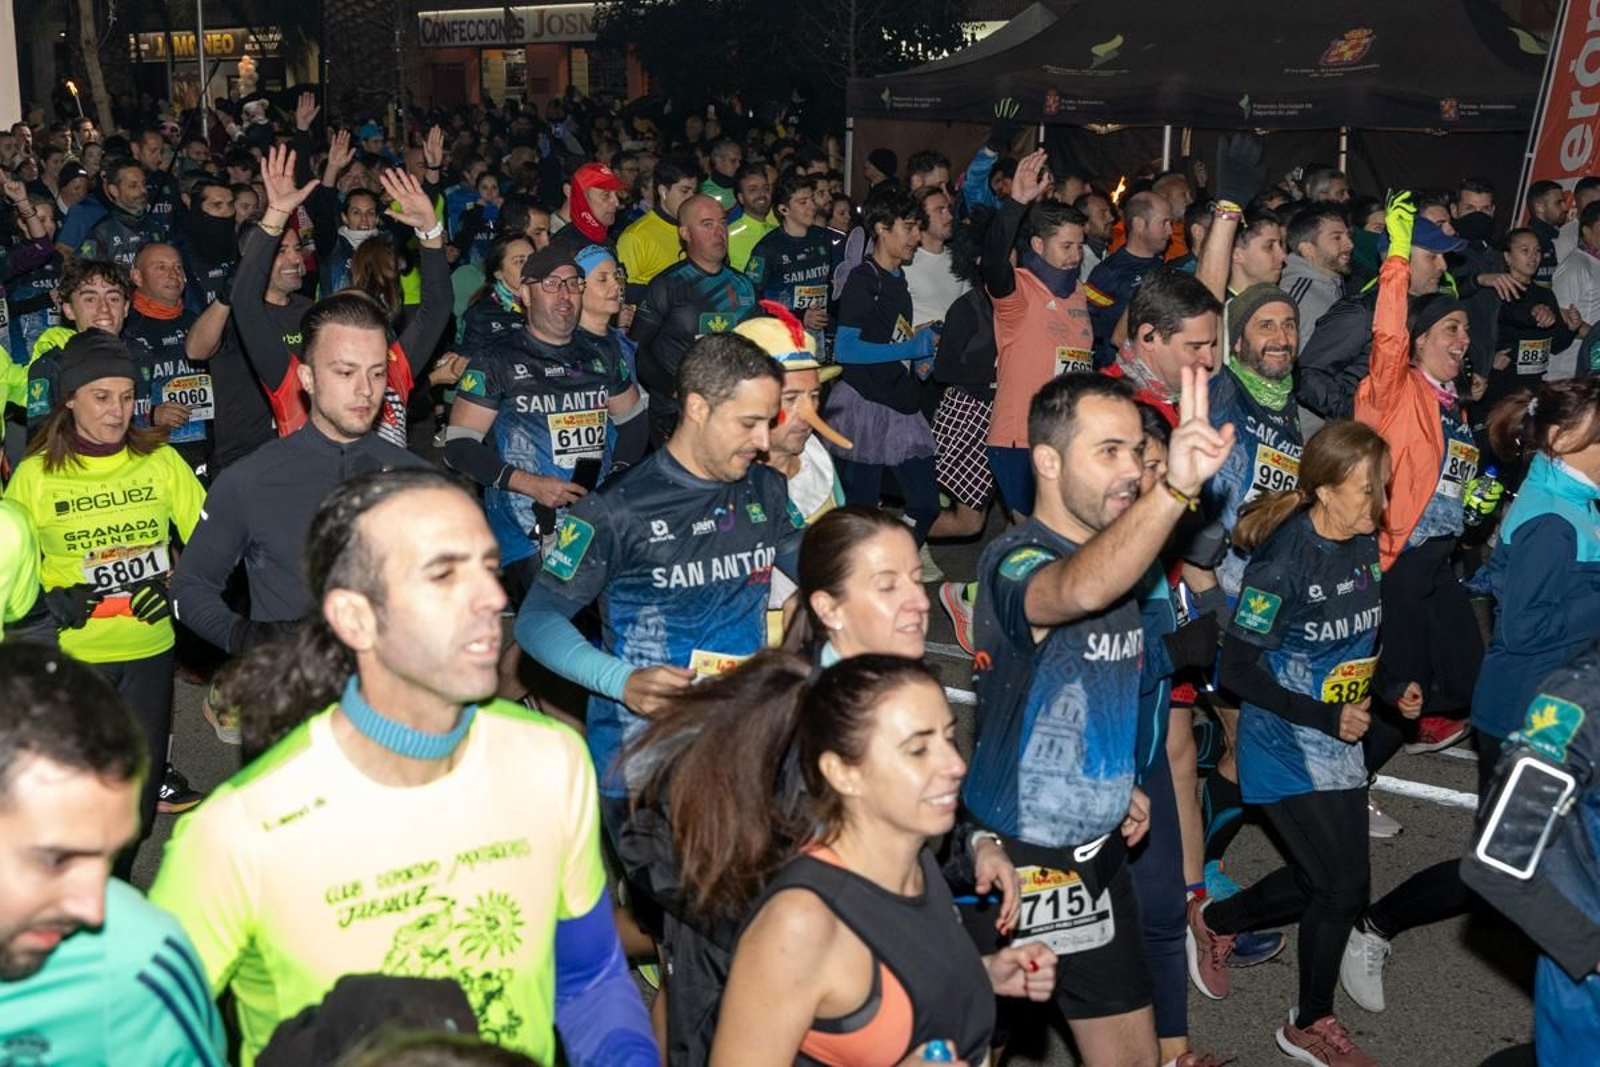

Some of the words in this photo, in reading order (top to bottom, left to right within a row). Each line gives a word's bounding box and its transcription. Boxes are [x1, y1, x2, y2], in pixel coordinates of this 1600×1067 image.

[421, 16, 525, 44] CONFECCIONS
[783, 271, 804, 284] SAN
[153, 360, 173, 378] AN
[167, 388, 207, 405] 8060
[515, 395, 556, 413] SAN
[562, 384, 609, 409] ANTÓ
[557, 426, 605, 448] 6102
[1245, 416, 1278, 447] SAN
[63, 518, 159, 542] GRANADA
[67, 529, 160, 551] RUNNERS
[93, 551, 160, 588] 6801
[652, 561, 704, 589] SAN
[1304, 617, 1349, 642] SAN
[1353, 600, 1382, 634] ANT
[1083, 631, 1120, 661] SAN
[1020, 884, 1097, 925] 715
